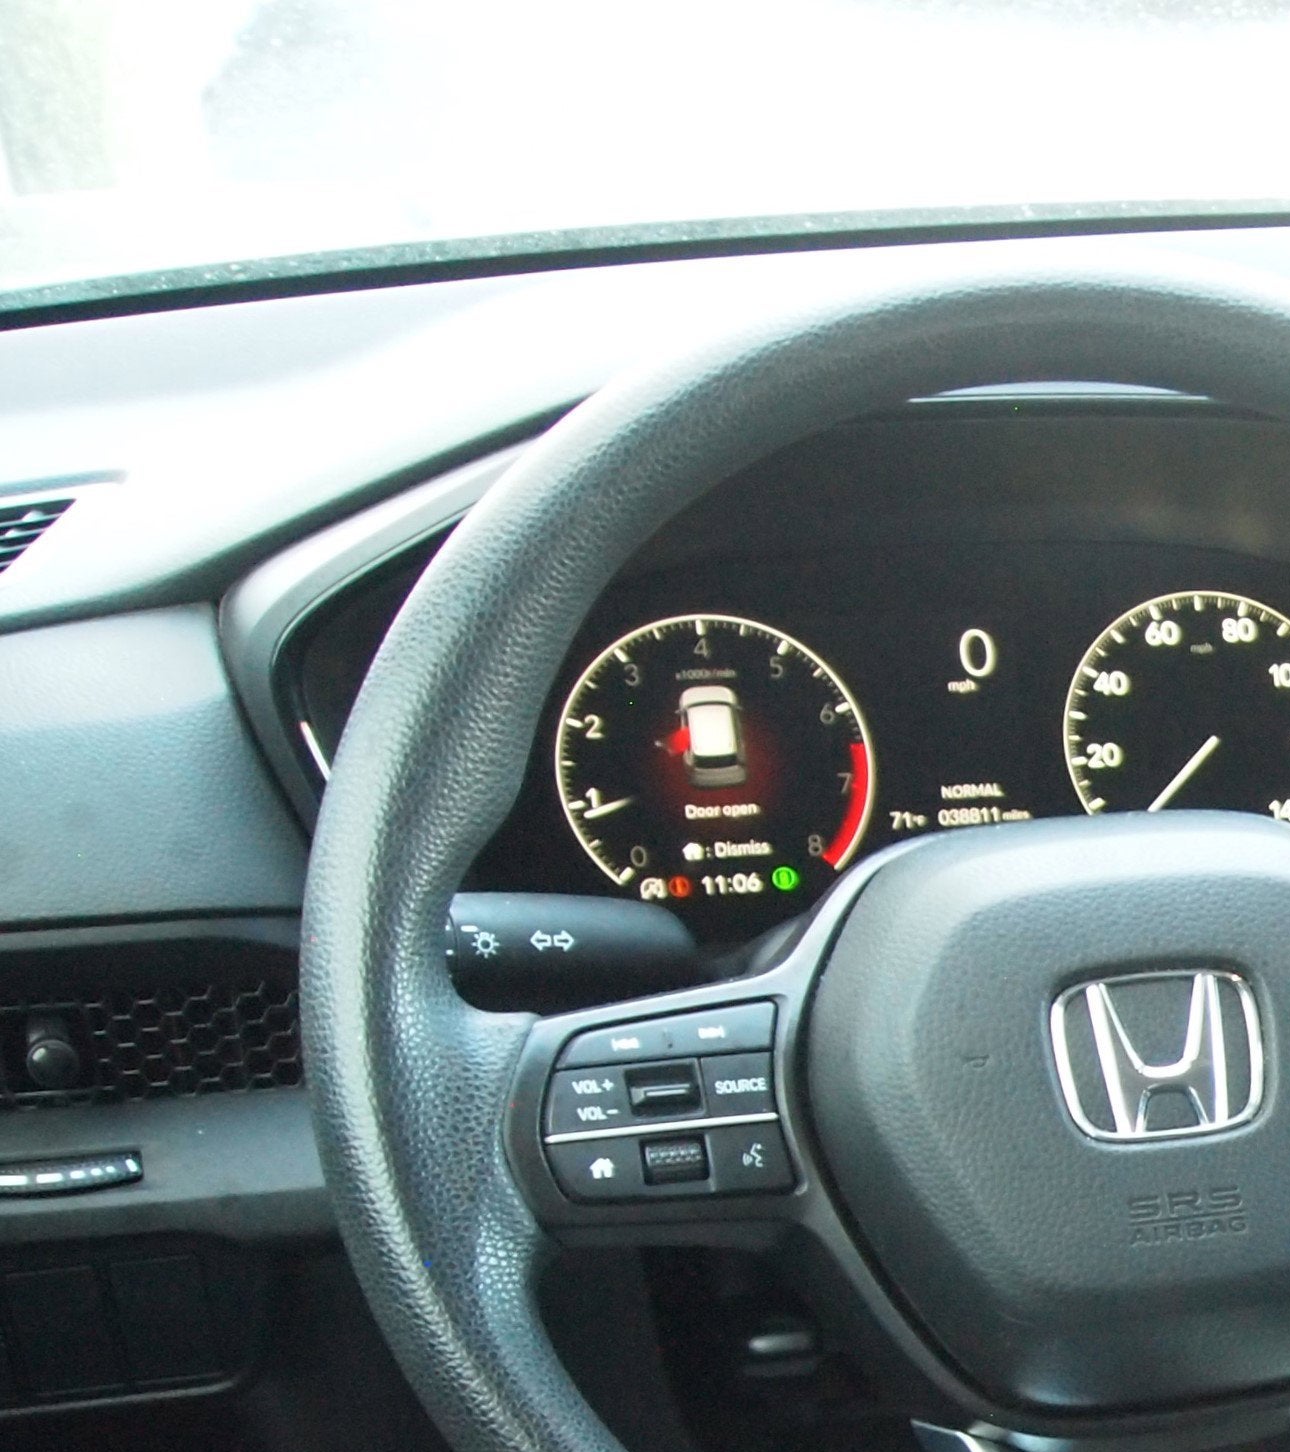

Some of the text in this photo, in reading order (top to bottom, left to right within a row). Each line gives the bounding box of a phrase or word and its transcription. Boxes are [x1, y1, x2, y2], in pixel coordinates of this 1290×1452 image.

[1144, 619, 1182, 647] 60
[1221, 617, 1258, 643] 80
[693, 639, 709, 659] 4
[959, 628, 996, 678] 0
[624, 664, 641, 687] 3
[769, 658, 784, 679] 5
[947, 679, 978, 693] mph
[1093, 670, 1130, 696] 40
[819, 703, 836, 724] 6
[584, 715, 605, 739] 2
[1085, 742, 1122, 768] 20
[837, 772, 852, 794] 7
[941, 783, 1004, 799] NORMAL
[585, 787, 600, 809] 1
[685, 803, 760, 819] Door open
[938, 806, 1000, 826] 038811
[629, 845, 648, 867] 0
[714, 839, 773, 858] Dismiss
[807, 834, 824, 857] 8
[701, 872, 764, 895] 11:06
[714, 1077, 767, 1095] SOURCE
[1128, 1185, 1244, 1219] SRS
[1131, 1216, 1247, 1248] AIRBAG
